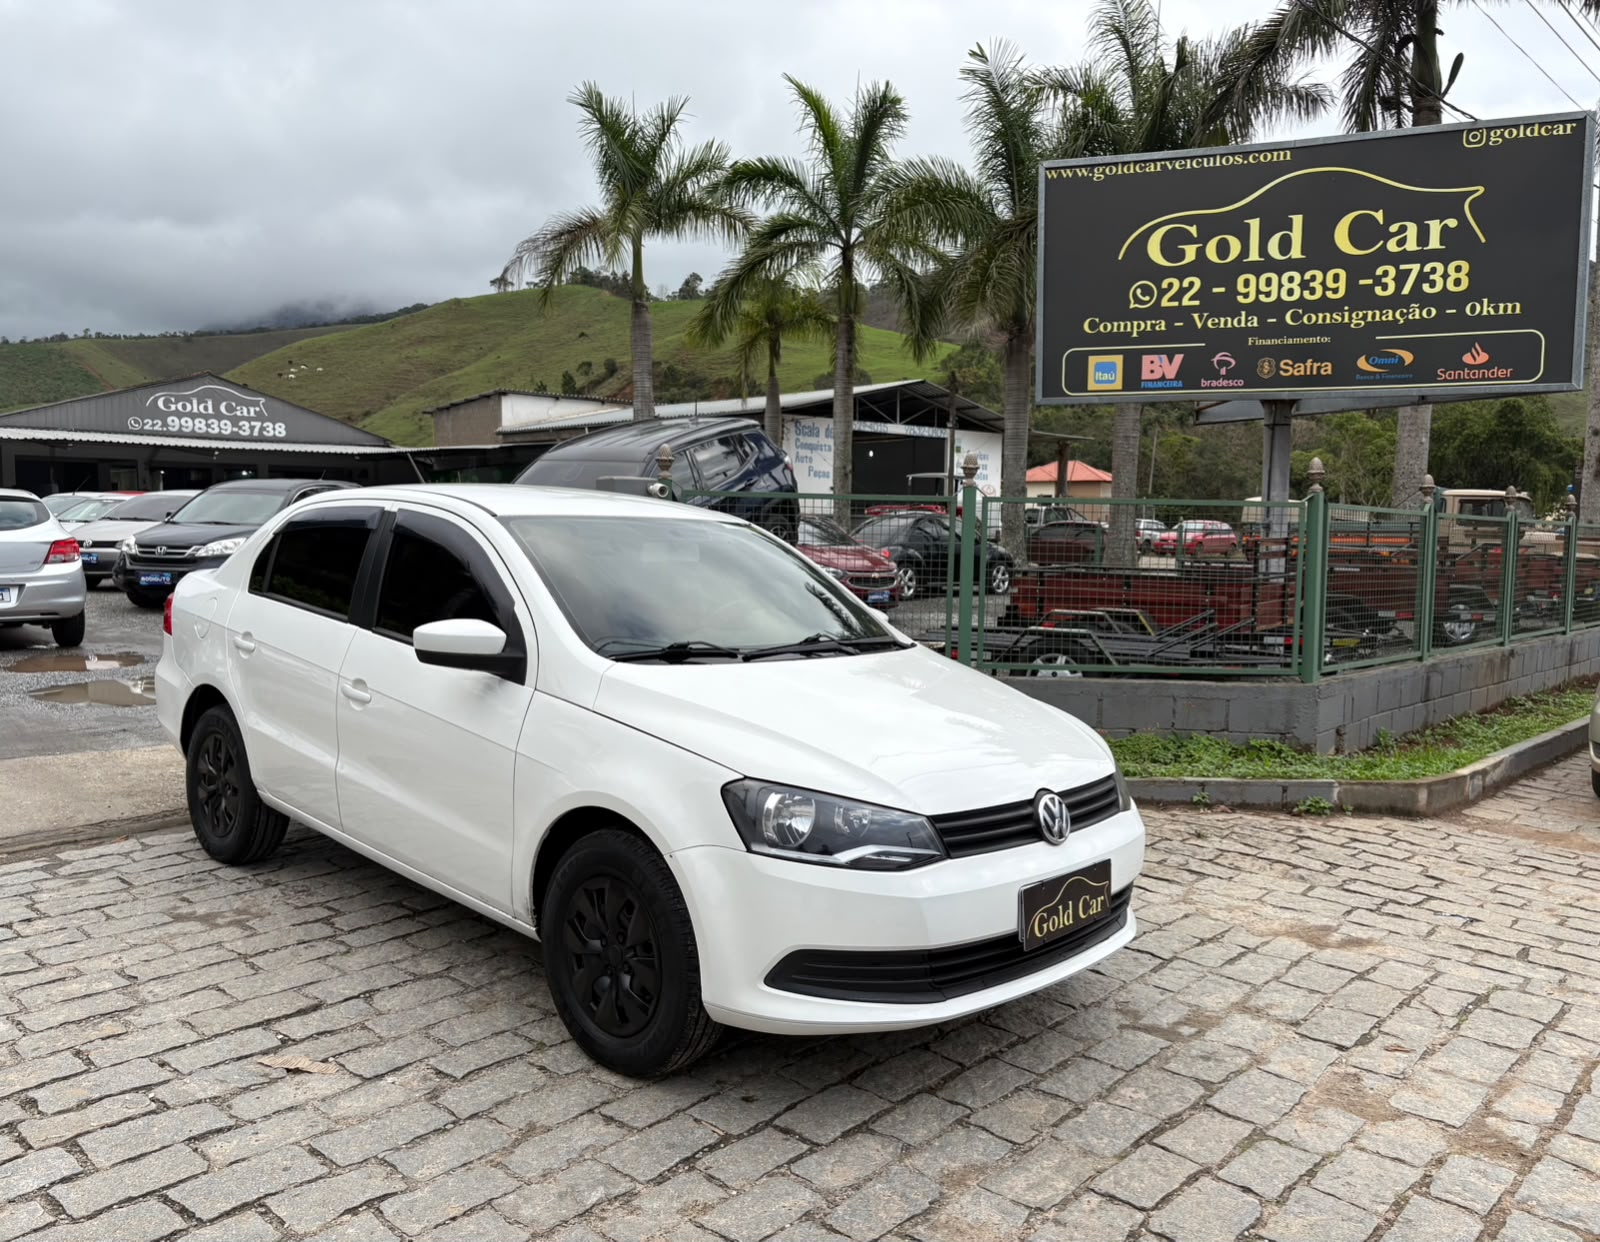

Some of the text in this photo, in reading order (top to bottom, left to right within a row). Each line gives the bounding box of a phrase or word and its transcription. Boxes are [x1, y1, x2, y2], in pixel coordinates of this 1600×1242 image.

[1489, 121, 1576, 146] goldcar
[1045, 150, 1292, 181] www.goldcarveiculos.com
[1147, 209, 1459, 267] Gold Car
[1160, 276, 1202, 307] 22
[1236, 268, 1347, 304] 99839
[1083, 316, 1167, 337] Compra
[1191, 311, 1259, 330] Venda
[1285, 303, 1437, 329] Consignação
[1465, 298, 1522, 317] 0km
[1248, 335, 1332, 346] Financiamento:
[1141, 354, 1185, 380] BV
[1279, 359, 1333, 377] Safra
[1369, 354, 1400, 366] Omni
[1095, 370, 1116, 381] Itaú
[1141, 380, 1184, 389] FINANCEIRA
[1201, 378, 1244, 388] bradesco
[1436, 366, 1514, 382] Santander
[157, 396, 260, 417] Gold Car
[143, 416, 287, 437] 22.99839-3738
[1034, 895, 1104, 938] Gold Car
